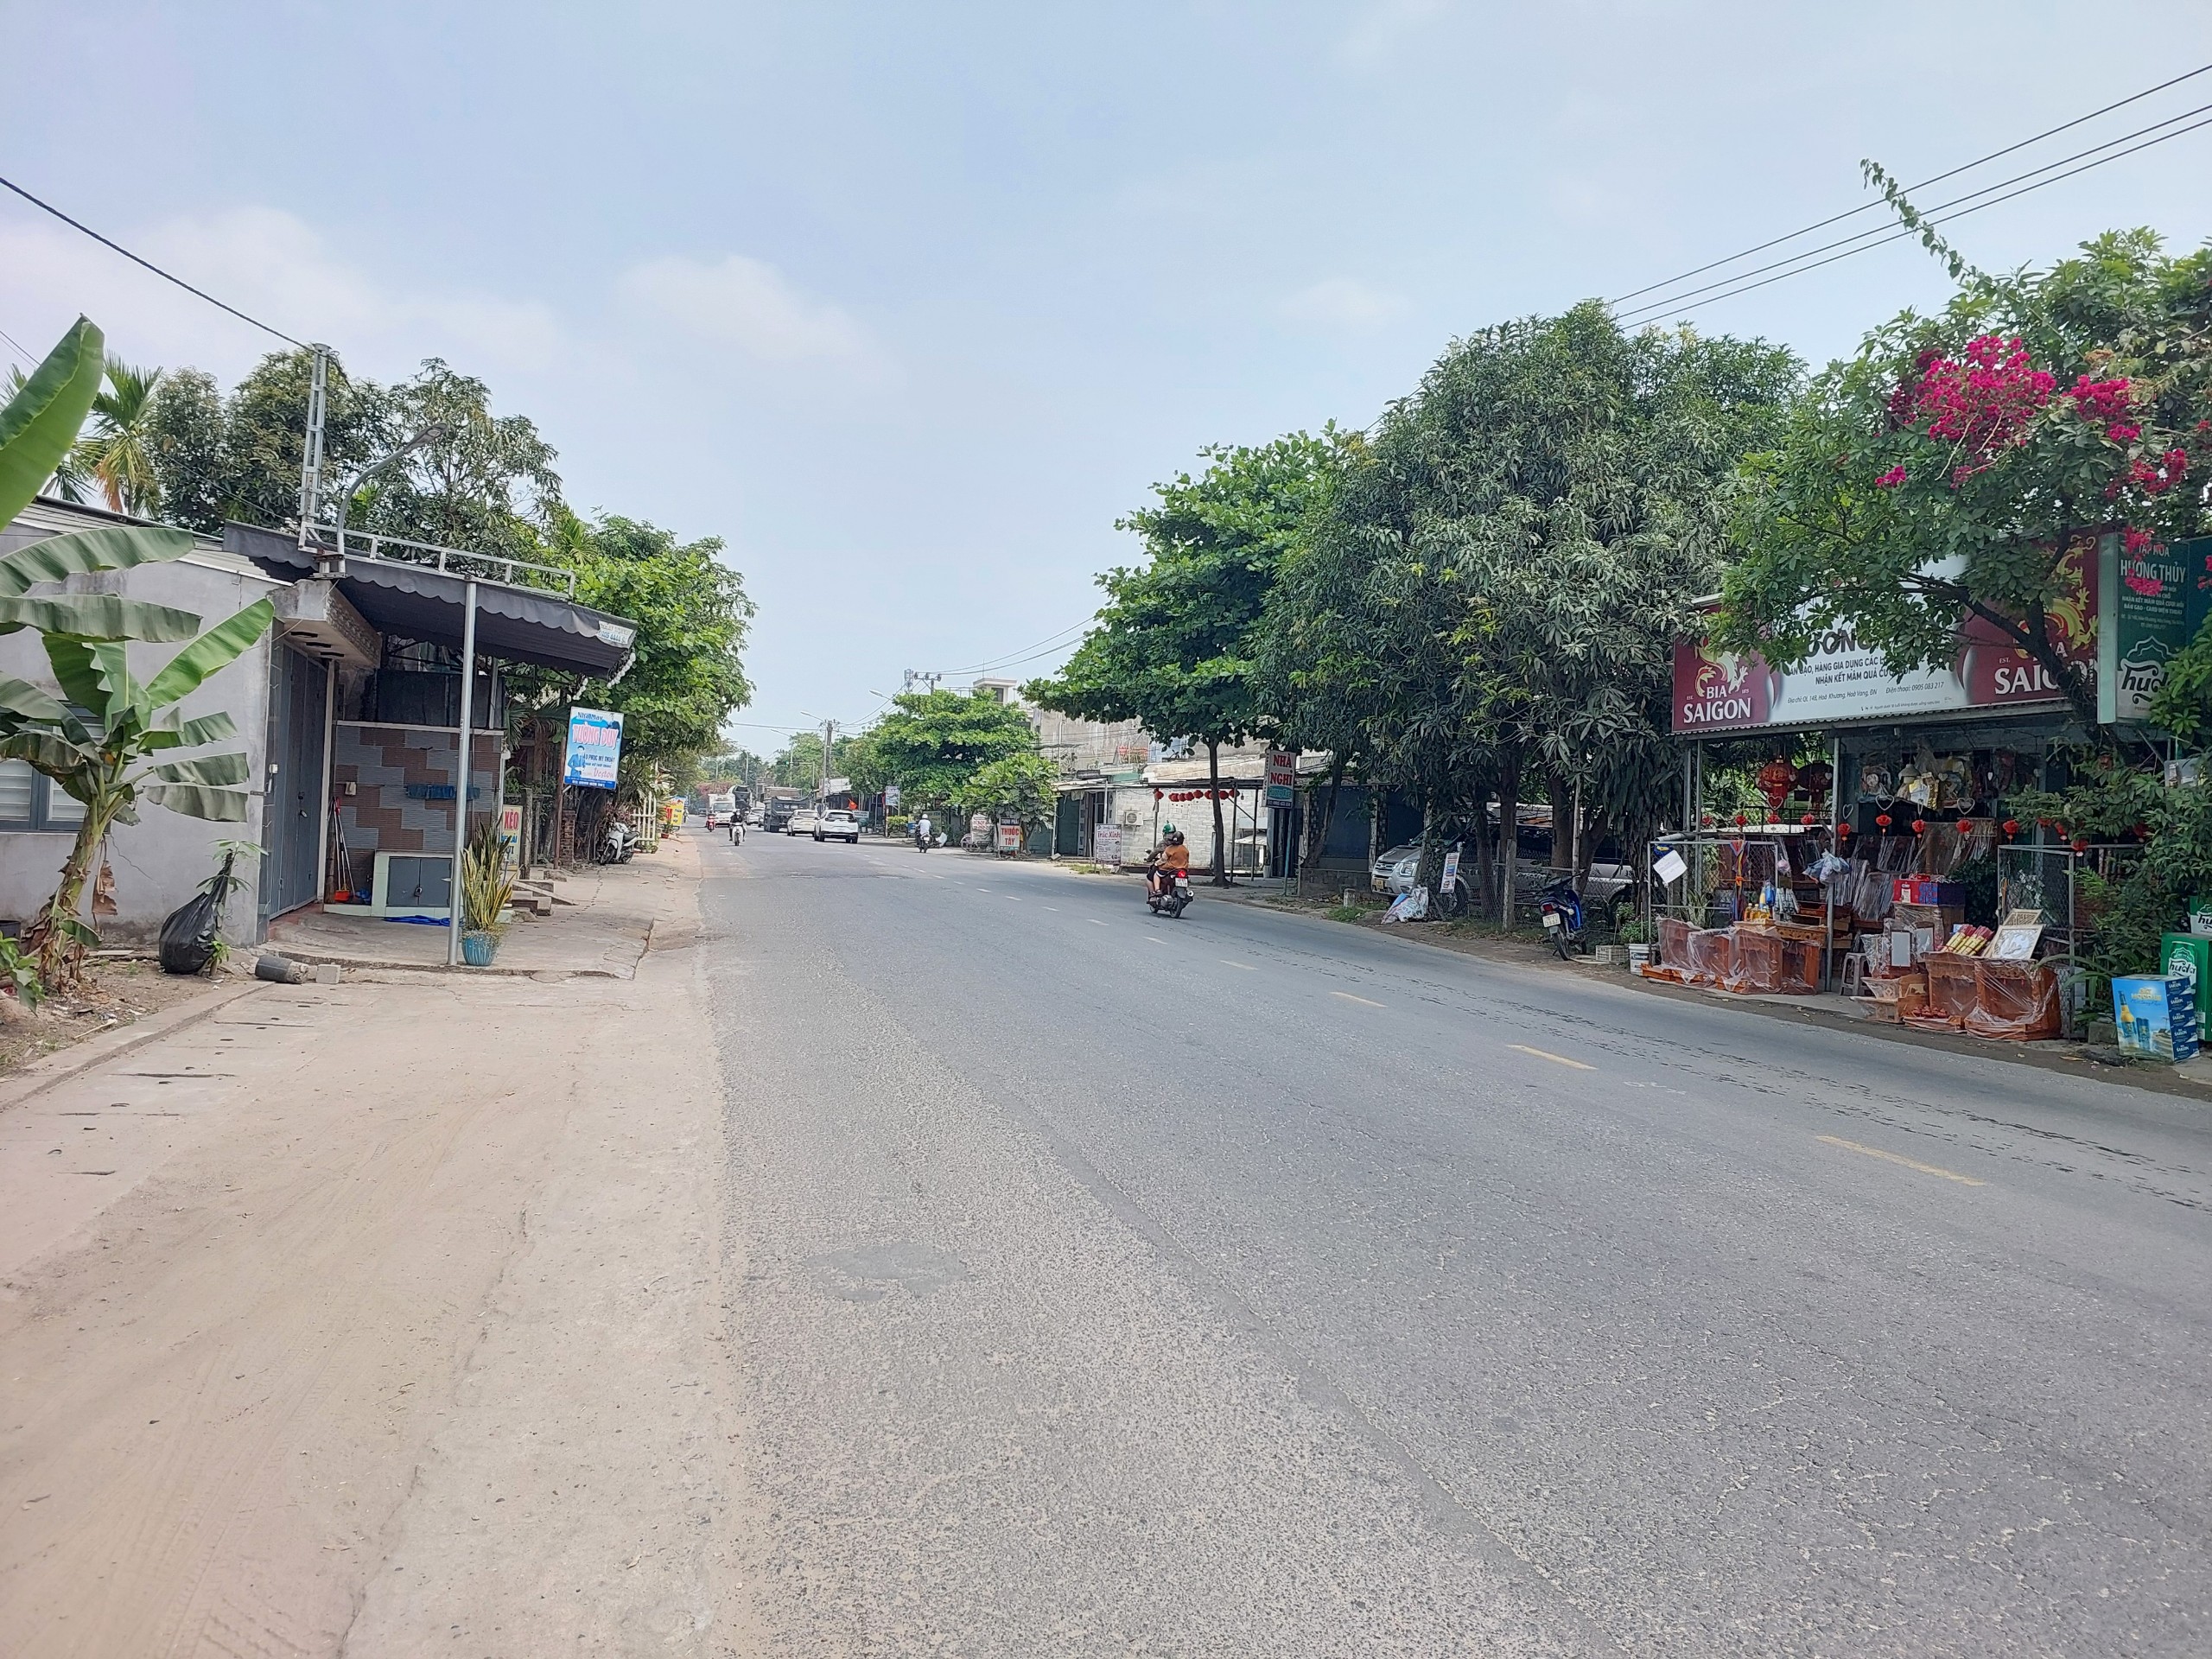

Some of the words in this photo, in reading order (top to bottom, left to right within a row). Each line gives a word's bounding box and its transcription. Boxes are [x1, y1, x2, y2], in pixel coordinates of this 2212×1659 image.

[2120, 559, 2157, 580] HƯƠNG
[2159, 562, 2186, 583] THỦY
[1815, 662, 1832, 672] HÀNG
[1846, 659, 1863, 671] DỤNG
[1865, 655, 1878, 665] CÁC
[1815, 674, 1833, 686] NHẬN
[1834, 671, 1846, 683] KẾT
[1847, 671, 1861, 682] MÂM
[1864, 667, 1878, 679] QUẢ
[2120, 664, 2170, 692] hud
[1707, 685, 1727, 699] BIA
[1684, 697, 1751, 723] SAIGON
[1273, 753, 1292, 768] NHÀ
[1270, 769, 1293, 785] NGHỈ
[1001, 826, 1020, 836] THUỐC
[1005, 836, 1015, 846] TÂY
[2170, 961, 2196, 974] huda
